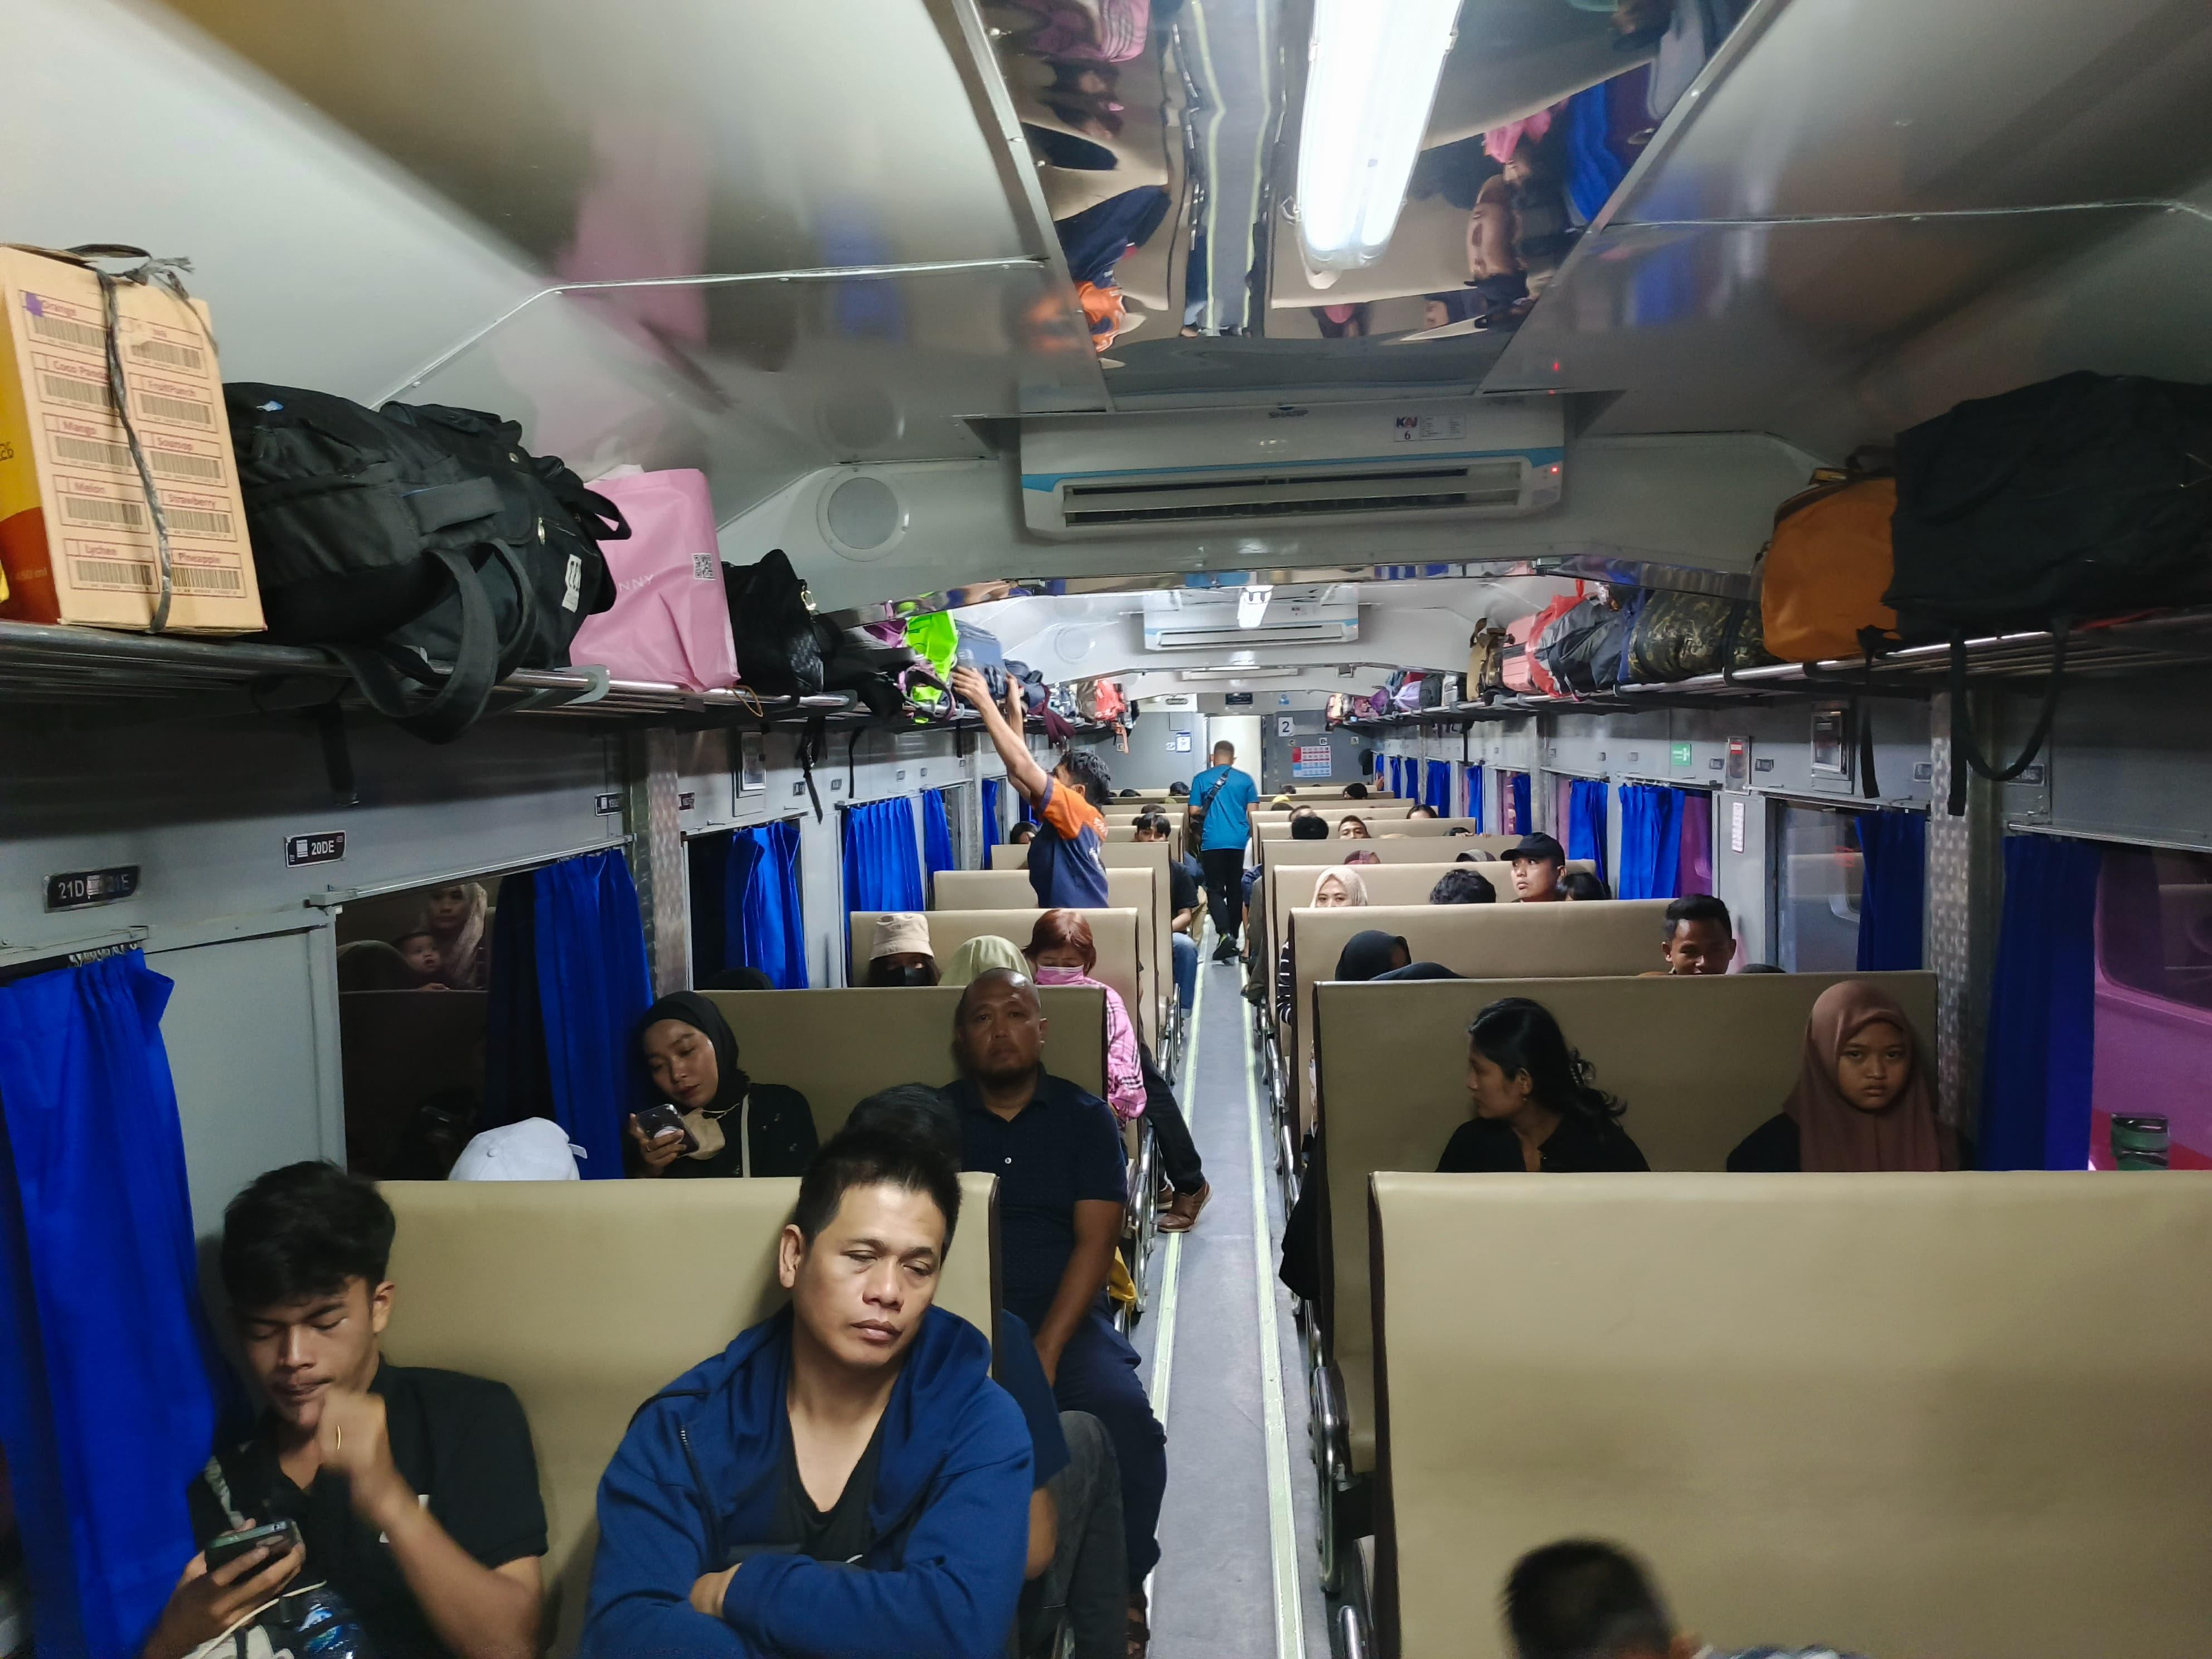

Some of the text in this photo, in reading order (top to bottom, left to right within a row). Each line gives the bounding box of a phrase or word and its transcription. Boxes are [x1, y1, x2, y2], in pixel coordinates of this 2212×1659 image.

[1405, 430, 1411, 440] 6
[1282, 721, 1290, 733] 2
[311, 840, 334, 856] 20DE
[58, 880, 84, 899] 21D
